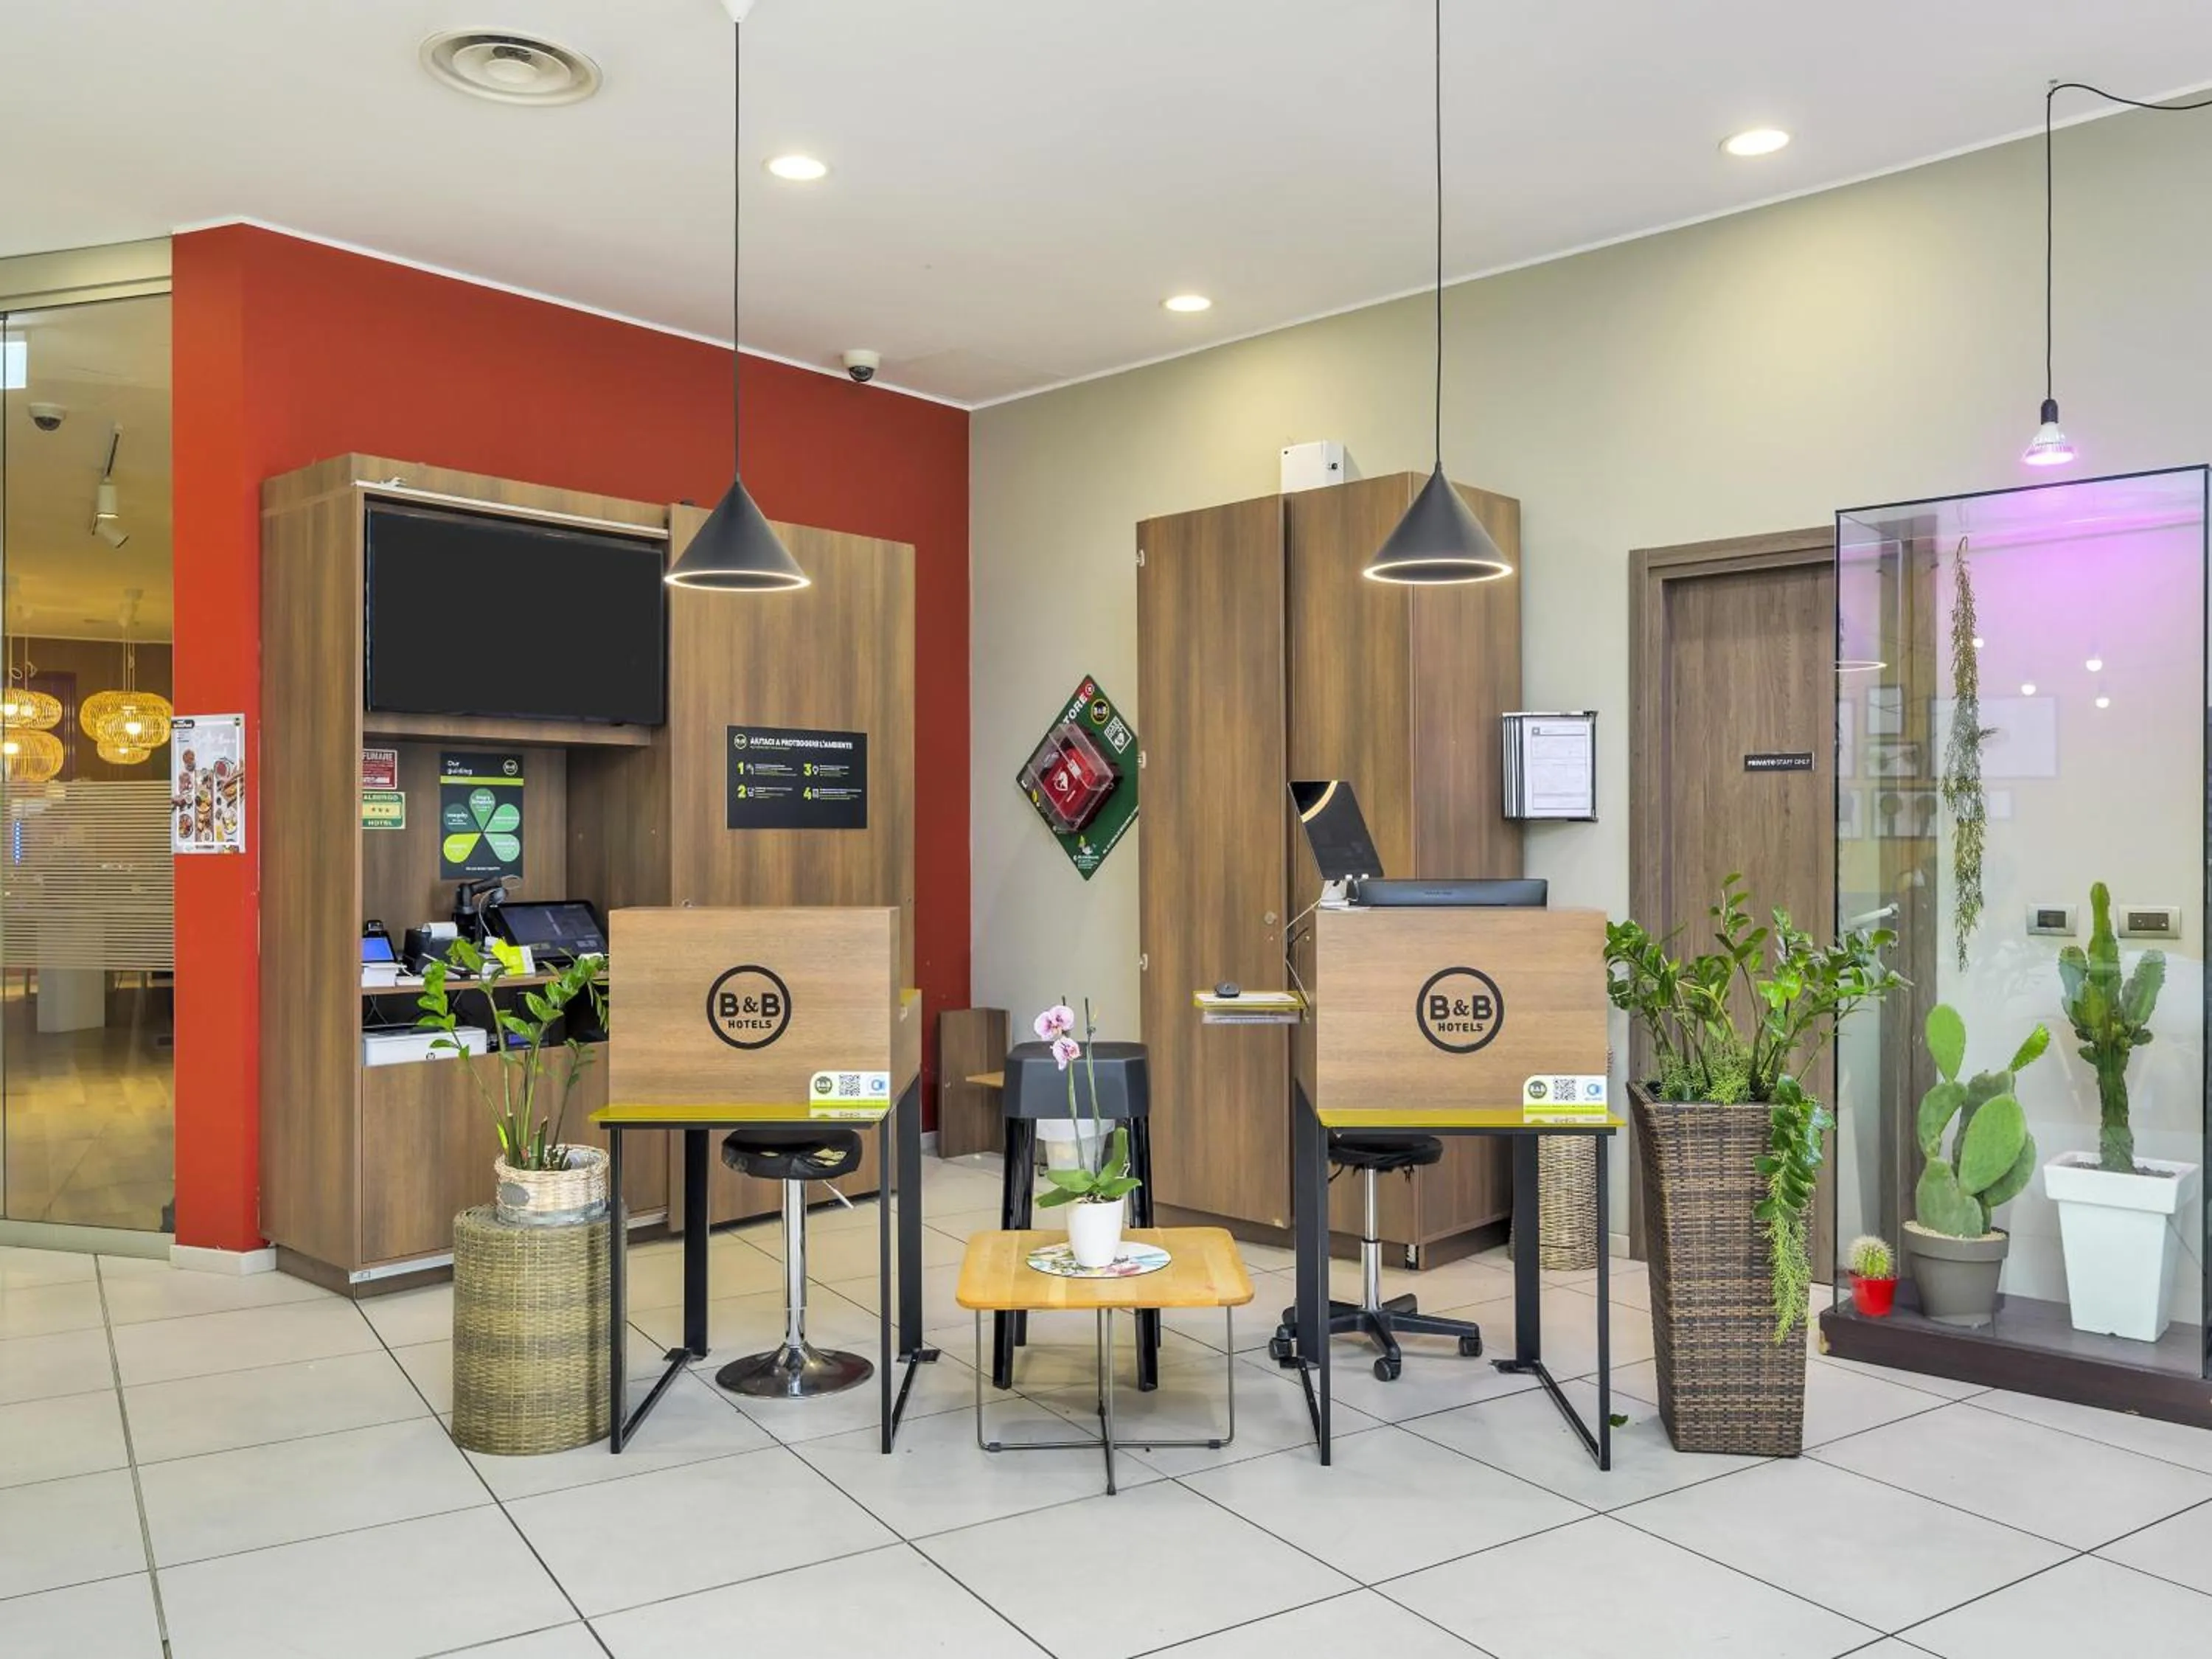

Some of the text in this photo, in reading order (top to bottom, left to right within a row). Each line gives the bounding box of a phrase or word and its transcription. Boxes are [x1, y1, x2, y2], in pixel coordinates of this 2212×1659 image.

[737, 761, 744, 775] 1
[804, 763, 812, 776] 3
[737, 784, 747, 799] 2
[803, 787, 812, 800] 4
[720, 992, 781, 1018] B&B
[1430, 995, 1493, 1020] B&B
[728, 1020, 773, 1029] HOTELS
[1438, 1023, 1484, 1032] HOTELS
